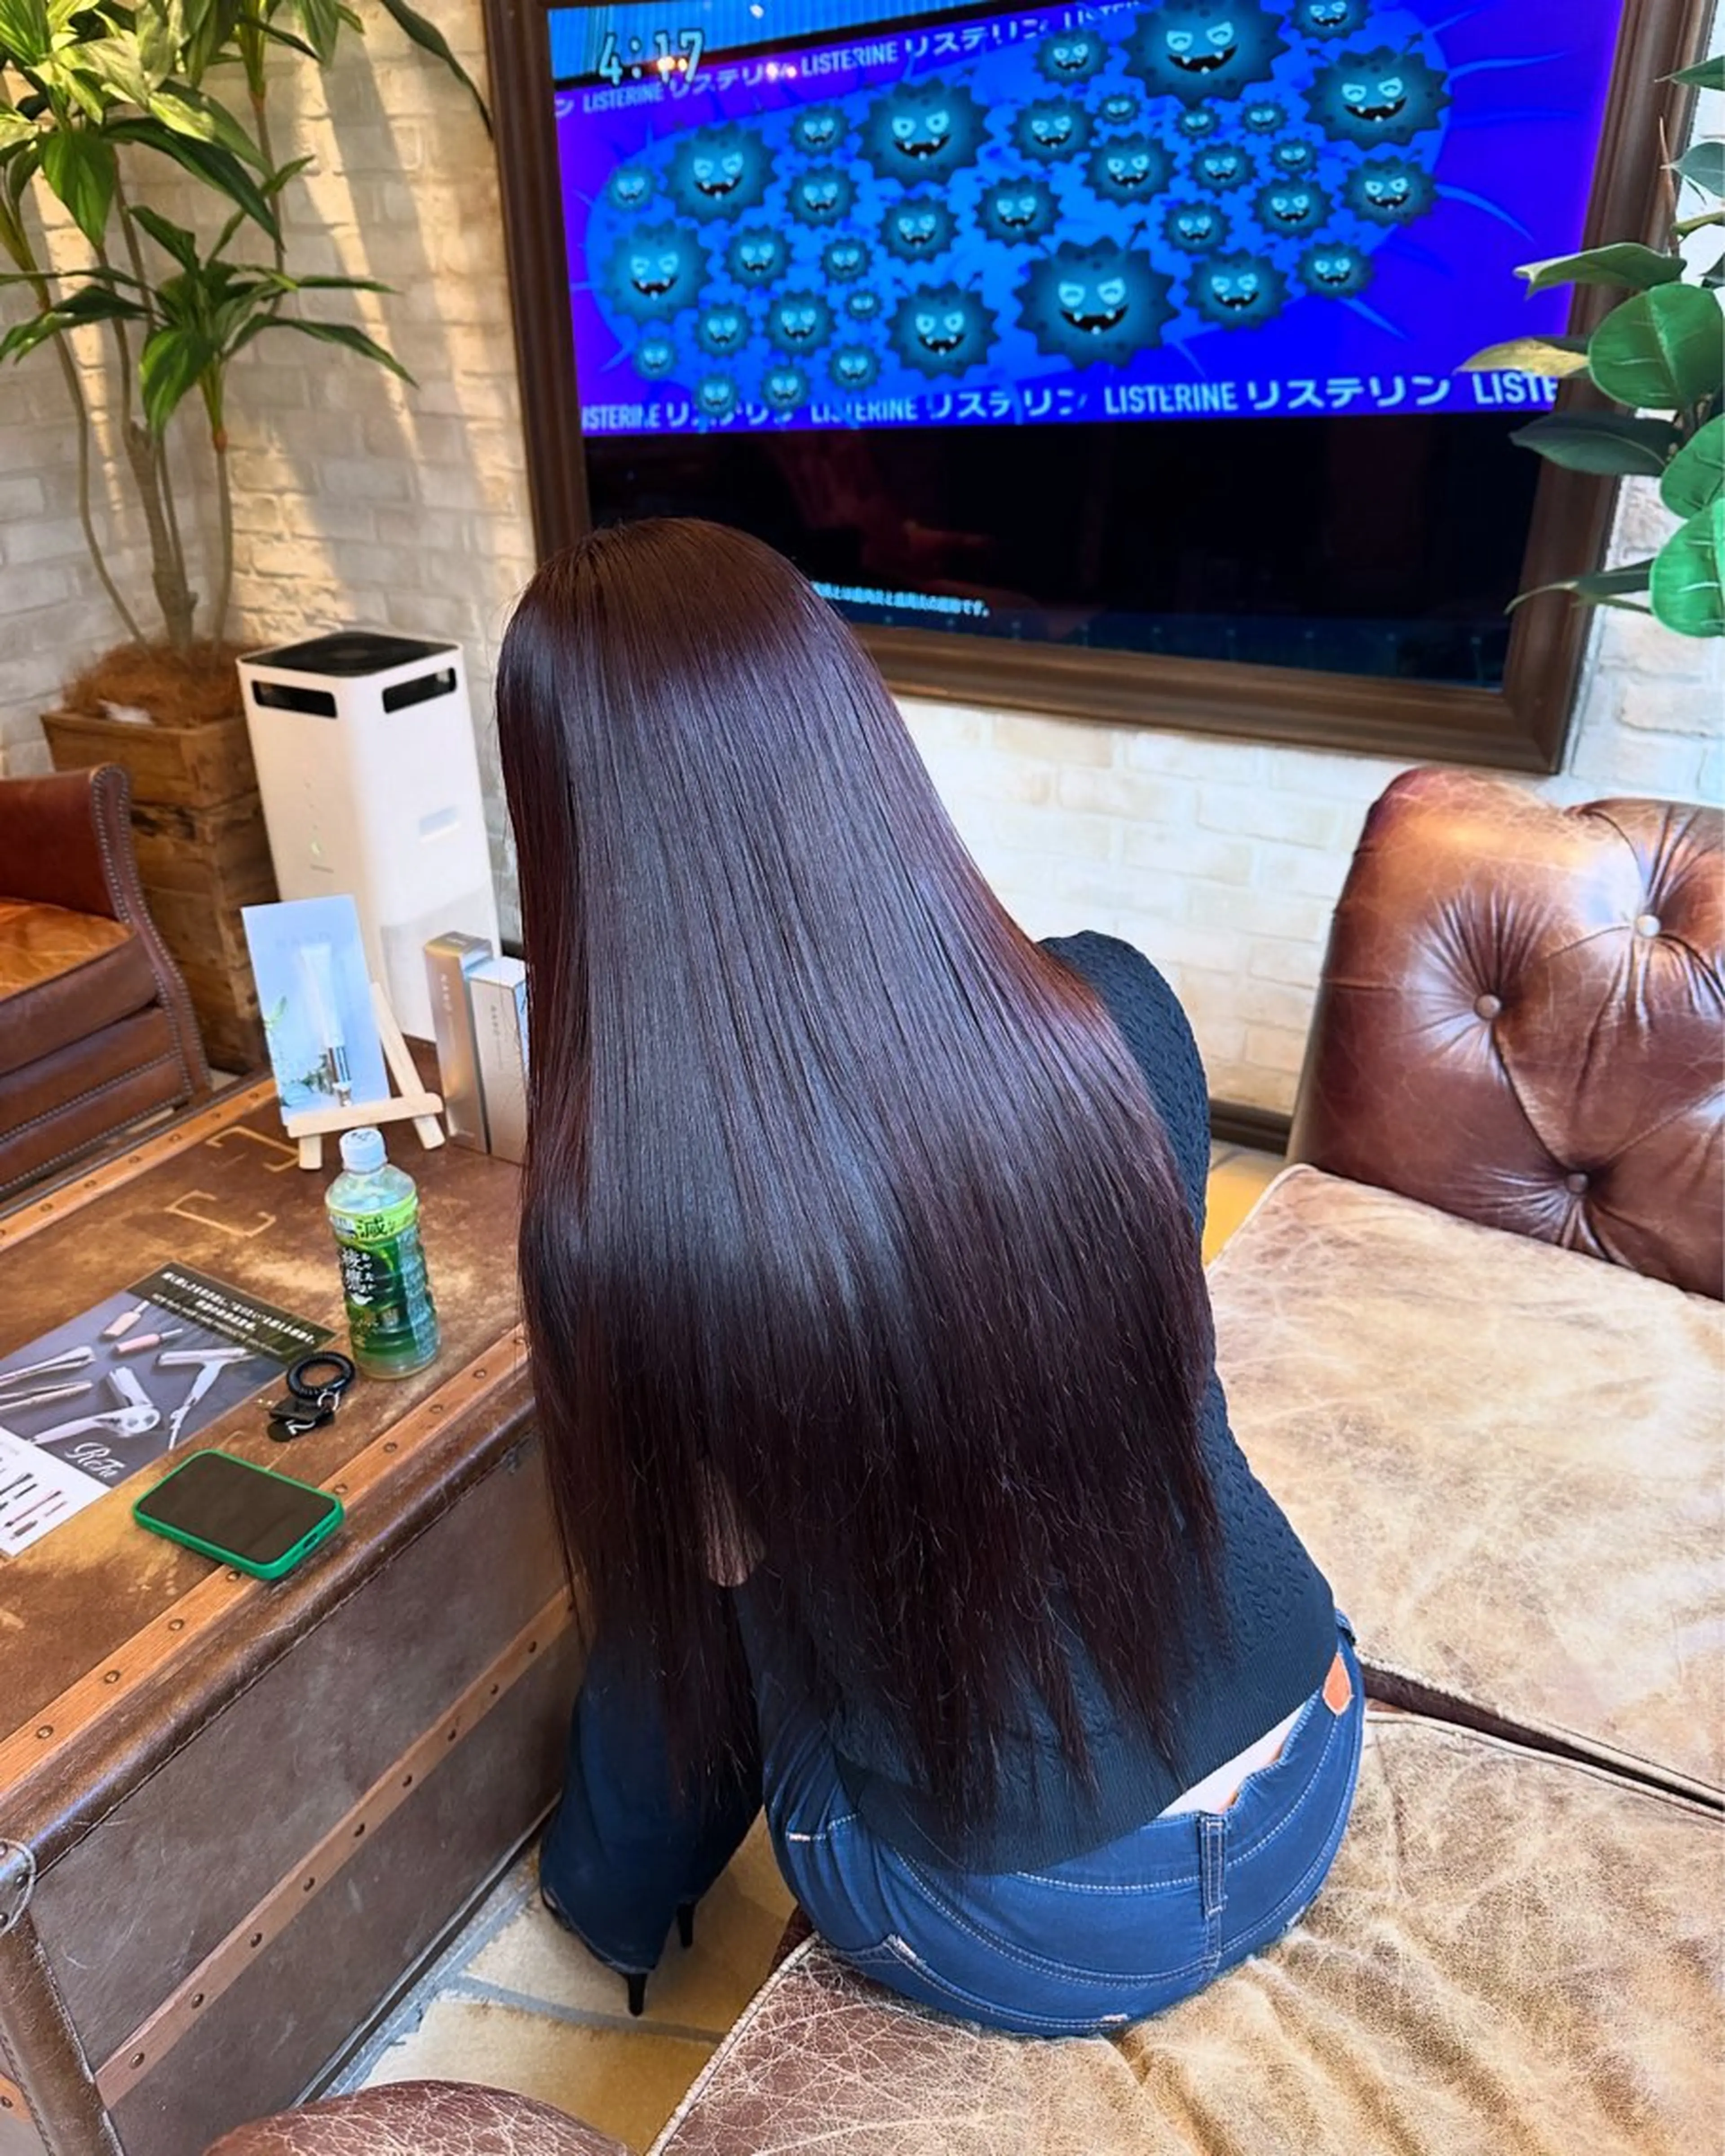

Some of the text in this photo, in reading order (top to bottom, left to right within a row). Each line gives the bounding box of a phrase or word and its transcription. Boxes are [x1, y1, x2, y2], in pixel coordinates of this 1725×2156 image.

[599, 31, 702, 85] 4:17
[801, 40, 898, 78] LISTERINE
[1104, 381, 1239, 415] LISTERINE
[1247, 376, 1451, 411] リステリン
